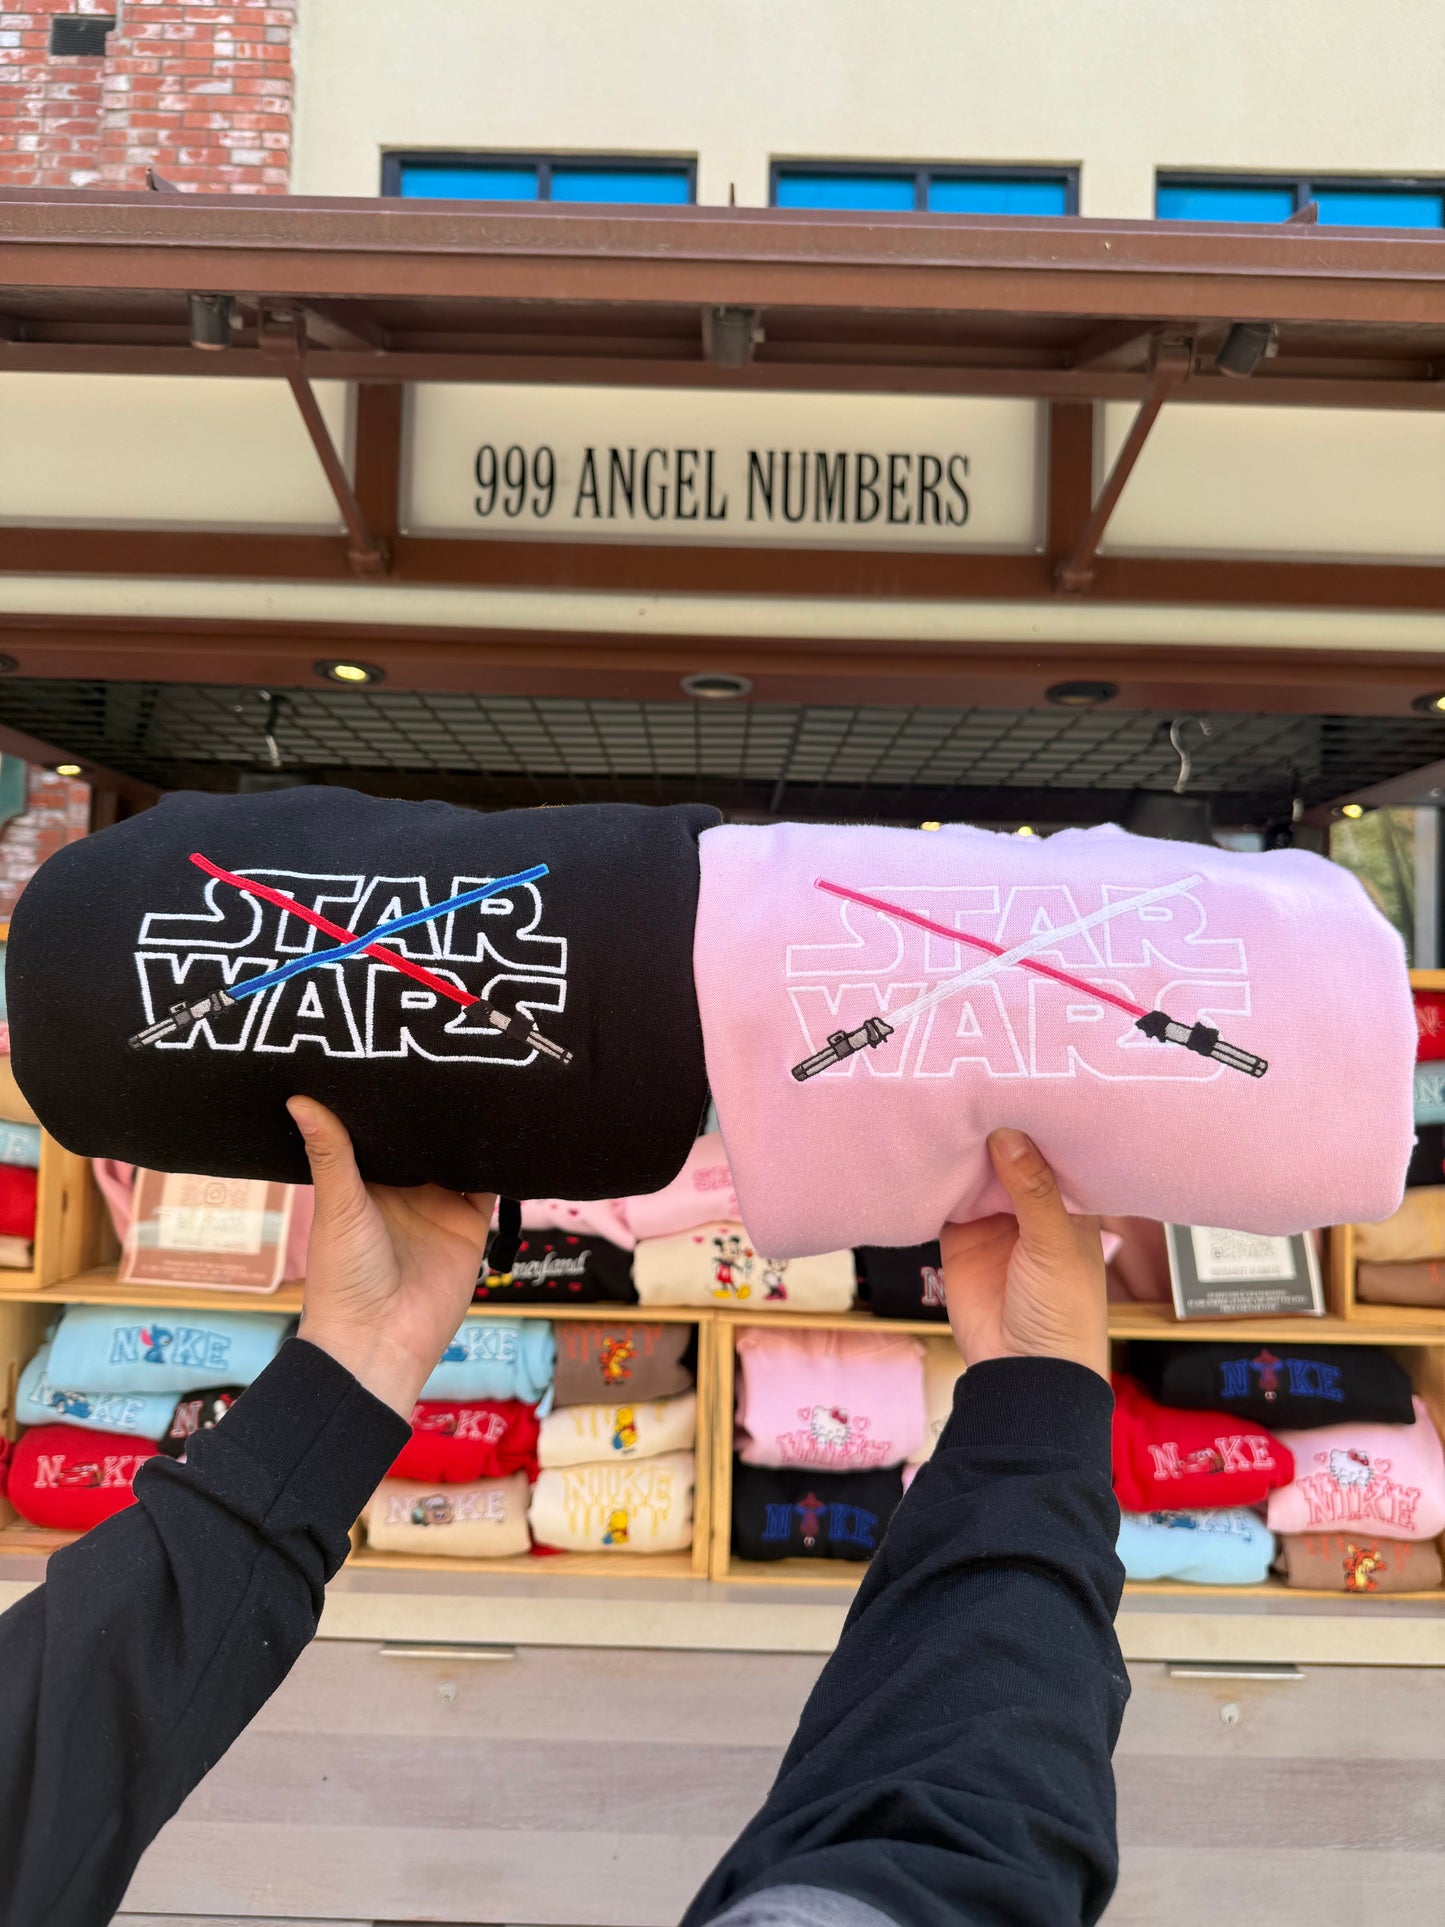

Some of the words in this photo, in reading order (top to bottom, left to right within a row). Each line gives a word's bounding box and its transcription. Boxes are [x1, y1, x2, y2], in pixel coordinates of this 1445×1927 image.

[474, 444, 556, 518] 999
[573, 447, 729, 521] ANGEL
[745, 450, 972, 527] NUMBERS
[137, 869, 568, 974] STAR
[785, 884, 1248, 976] STAR
[134, 951, 568, 1066] WARS
[786, 978, 1252, 1083] WARS
[110, 1325, 232, 1371] NKE
[28, 1371, 143, 1430] NKE
[1220, 1358, 1345, 1402] NKE
[1147, 1434, 1276, 1481] NKE
[386, 1490, 505, 1525] NKE
[762, 1502, 878, 1549] NKE
